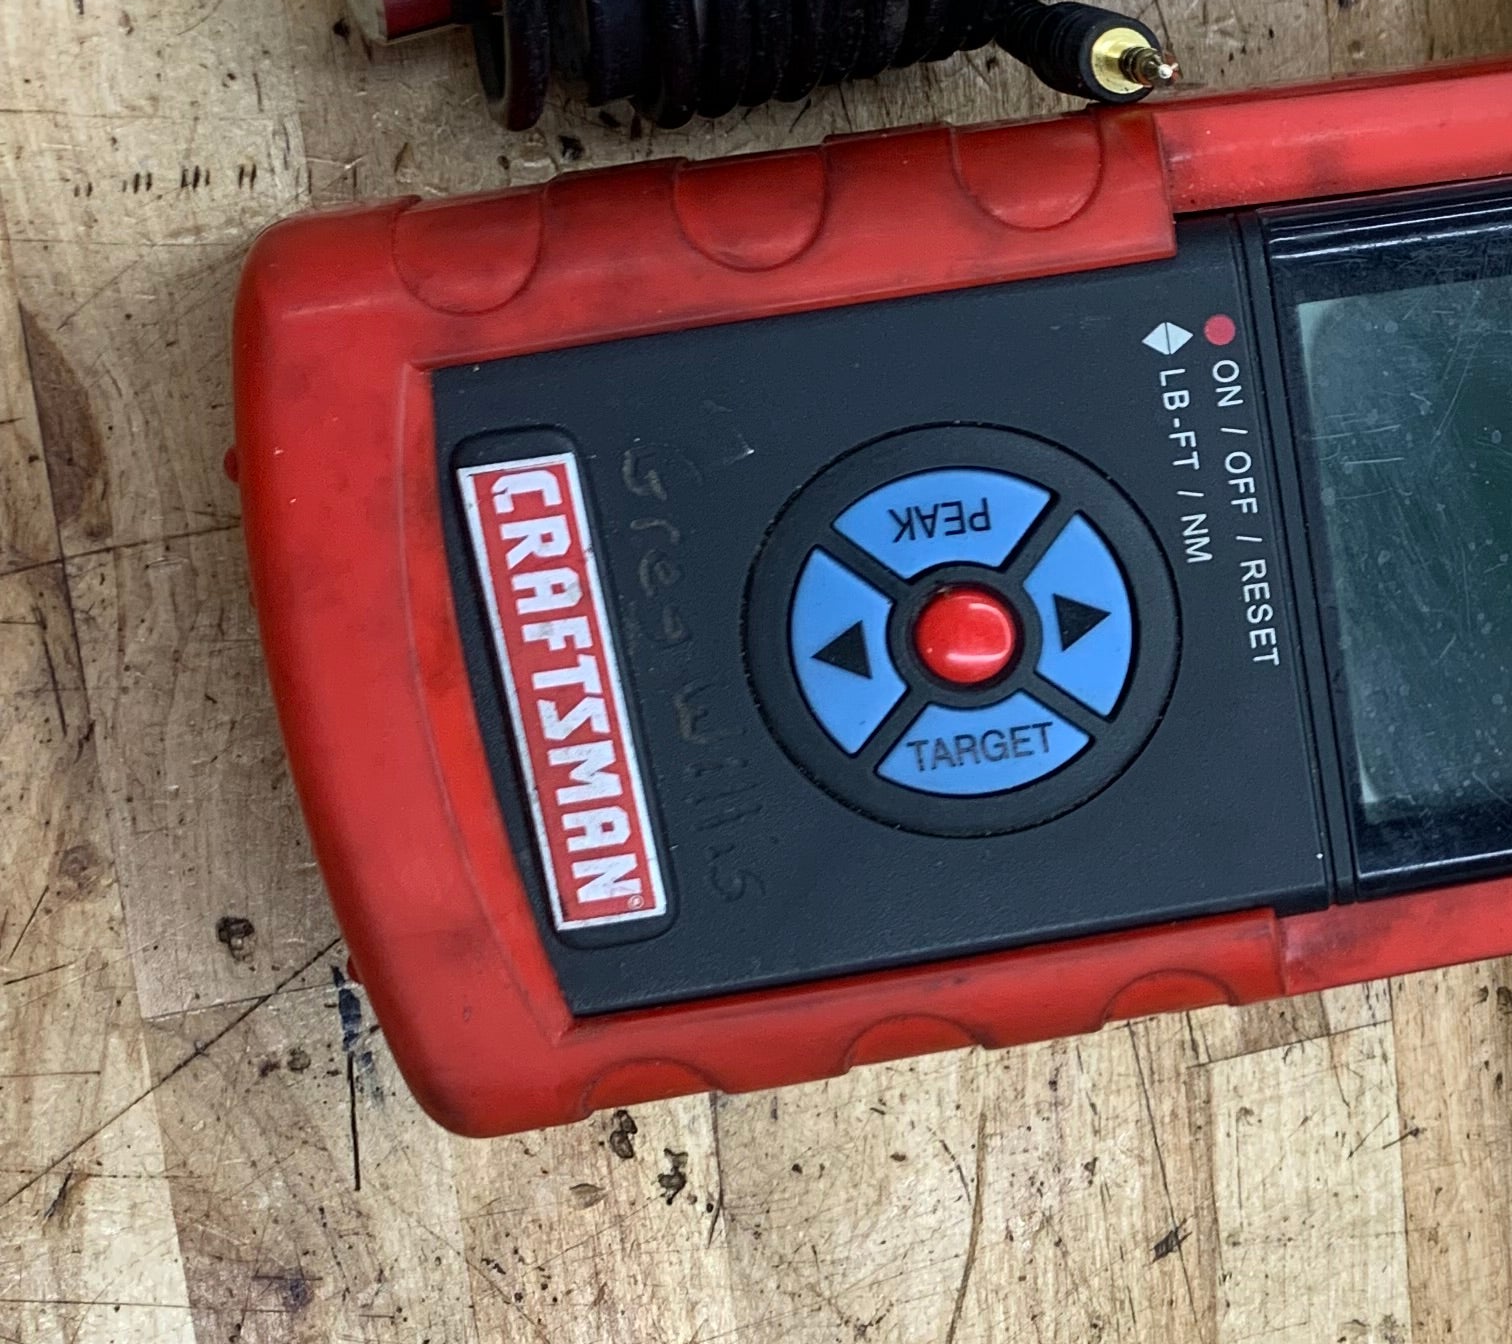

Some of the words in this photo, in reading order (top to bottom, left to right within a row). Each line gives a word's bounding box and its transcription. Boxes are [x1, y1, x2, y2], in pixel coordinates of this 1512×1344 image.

[1212, 359, 1245, 408] ON
[1224, 451, 1259, 514] OFF
[887, 497, 992, 544] PEAK
[1180, 514, 1213, 565] NM
[1239, 560, 1280, 667] RESET
[906, 721, 1054, 773] TARGET
